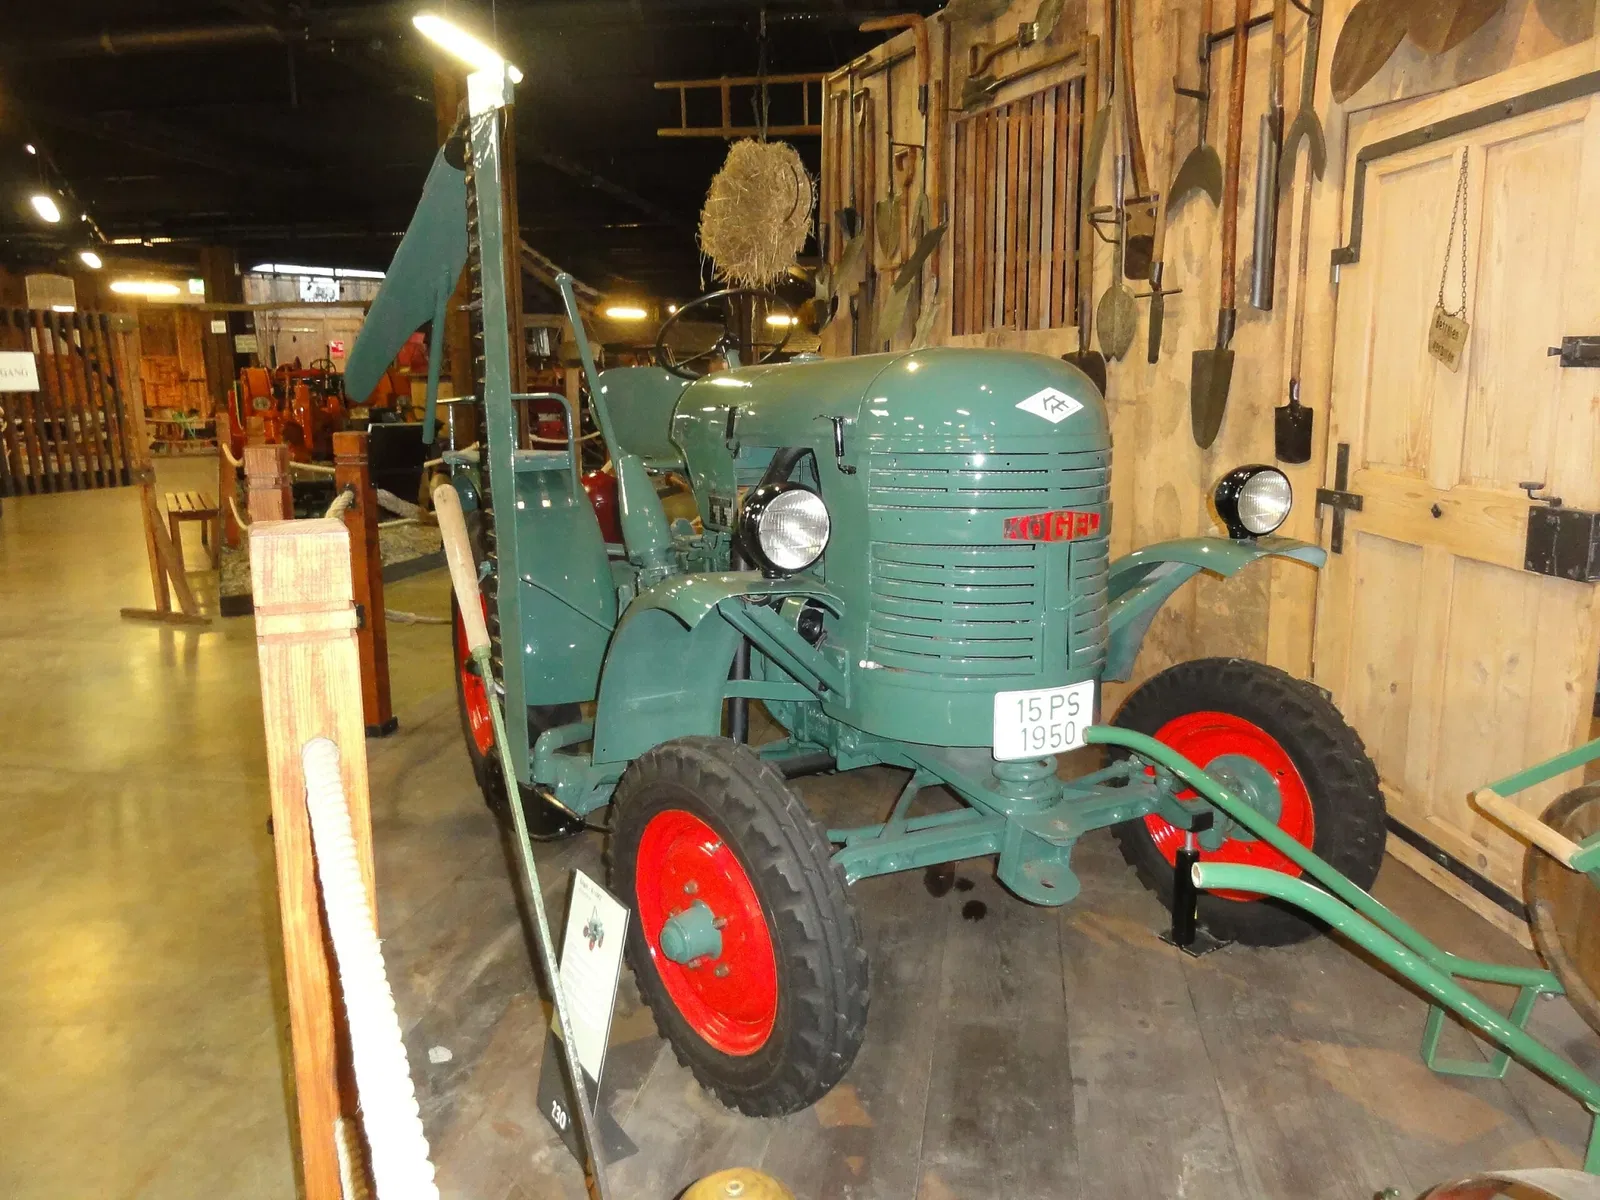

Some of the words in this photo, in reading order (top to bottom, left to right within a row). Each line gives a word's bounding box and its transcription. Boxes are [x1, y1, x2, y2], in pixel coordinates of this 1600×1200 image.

[1017, 697, 1042, 723] 15
[1050, 691, 1080, 720] PS
[1021, 720, 1075, 752] 1950
[551, 1099, 567, 1130] 230
